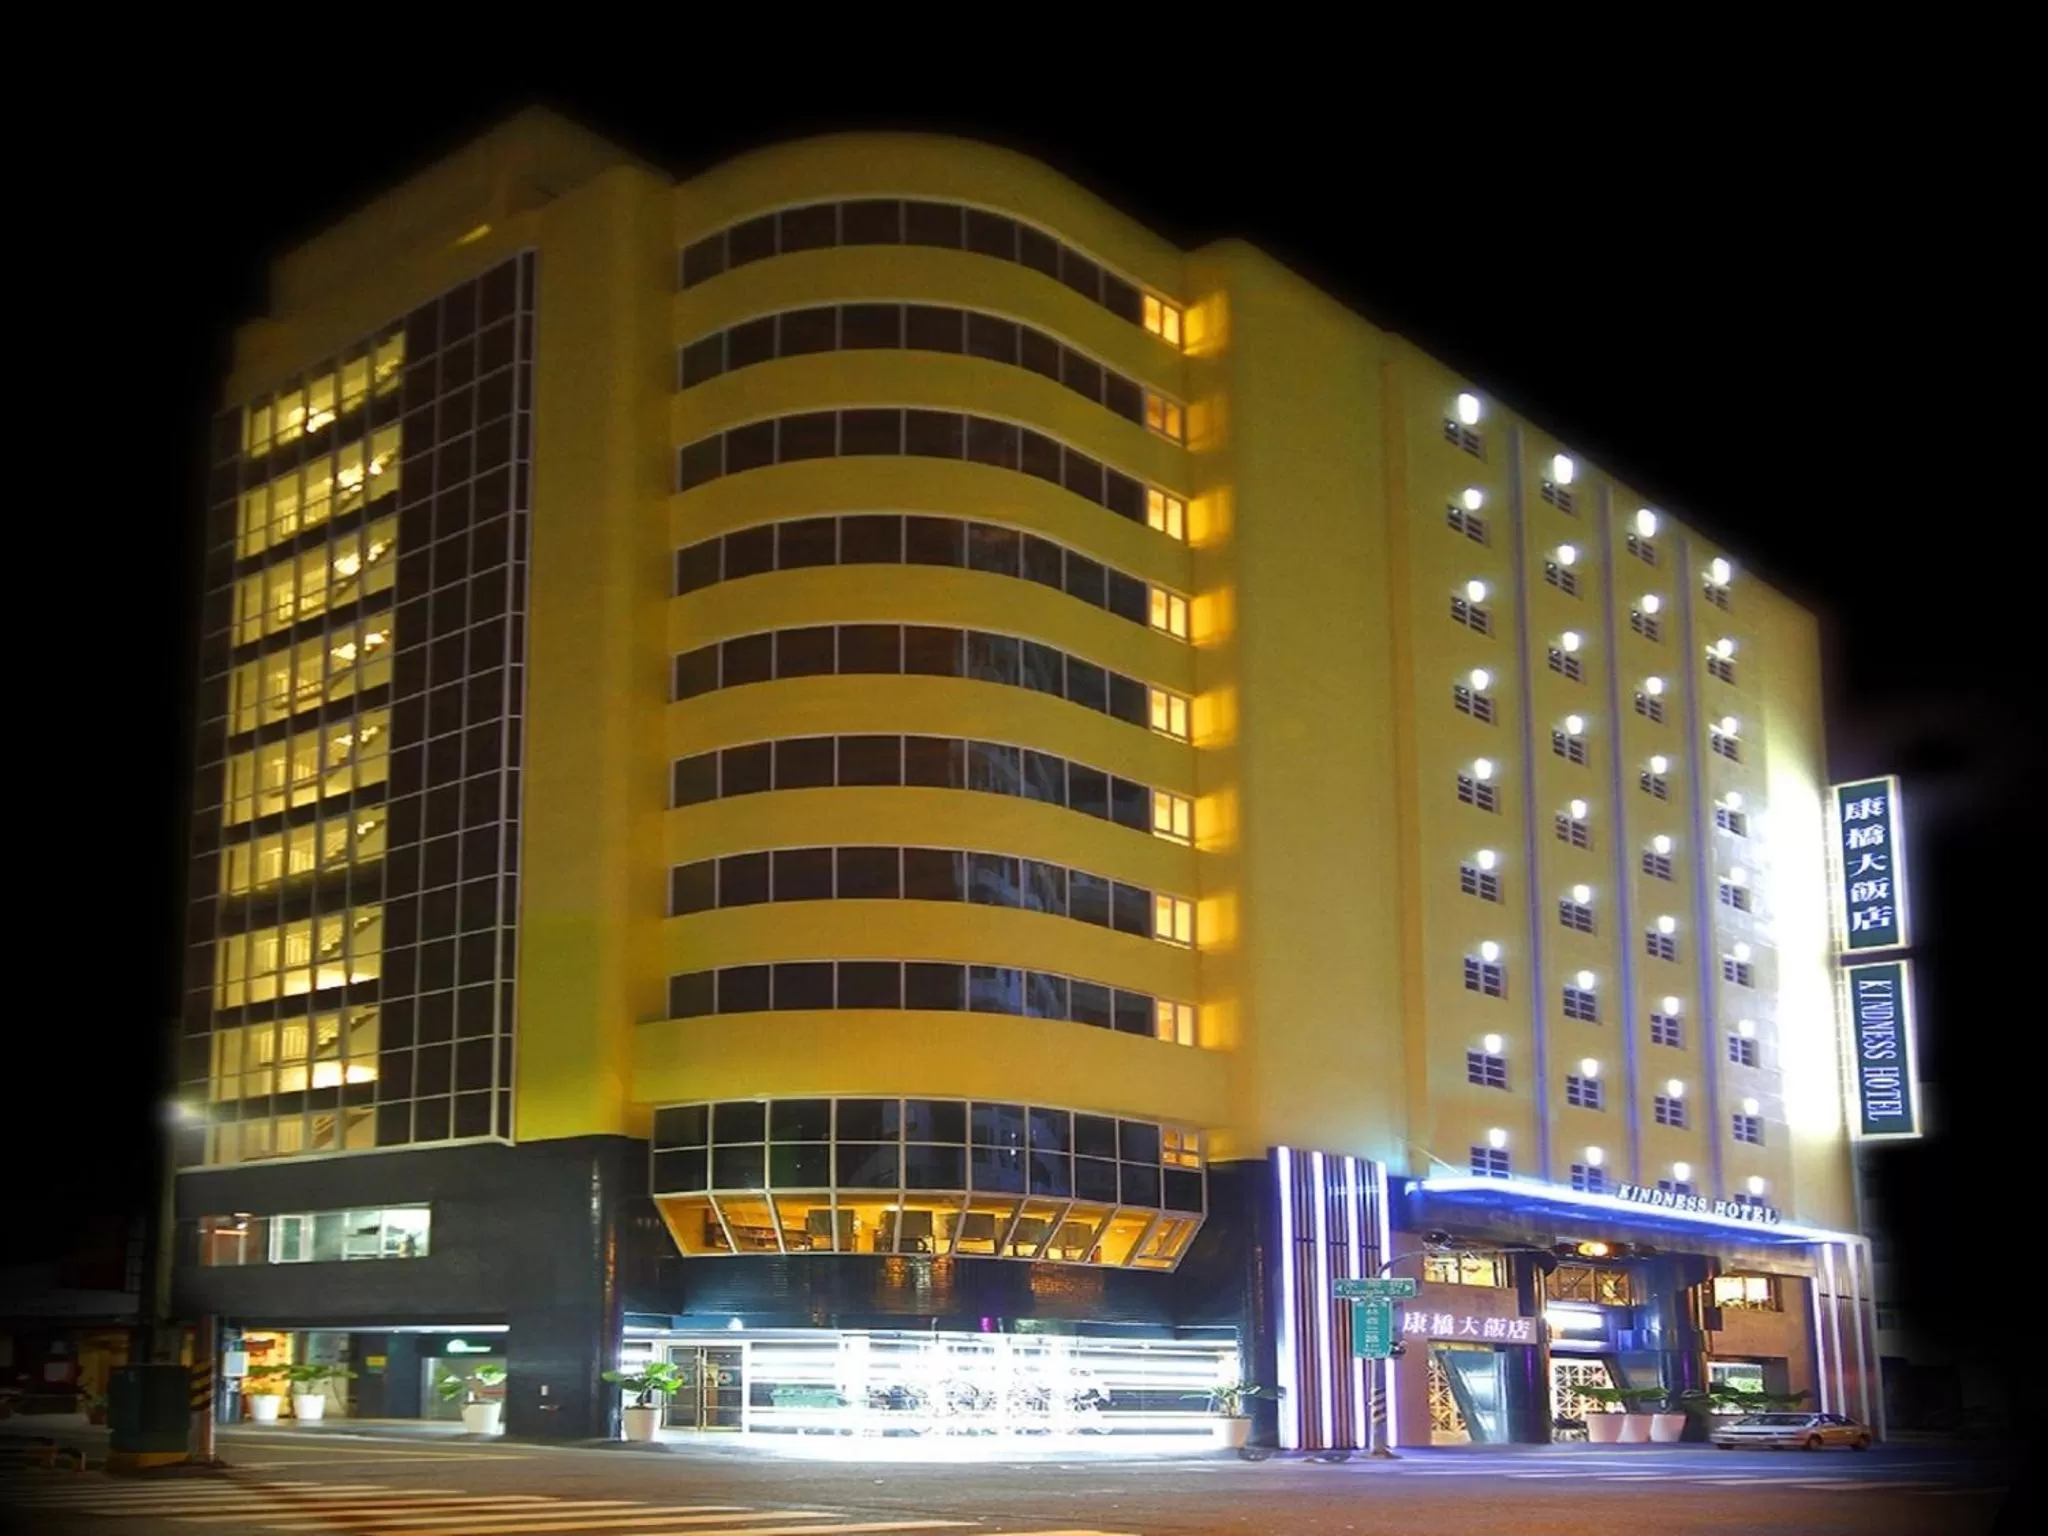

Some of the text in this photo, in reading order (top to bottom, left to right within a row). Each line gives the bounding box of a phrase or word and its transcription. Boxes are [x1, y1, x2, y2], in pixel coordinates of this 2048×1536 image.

[1844, 796, 1891, 932] 康橋大飯店
[1859, 979, 1902, 1121] KINDNESS HOTEL
[1618, 1184, 1777, 1224] KINDNESS HOTEL
[1402, 1312, 1530, 1339] 康橋大飯店
